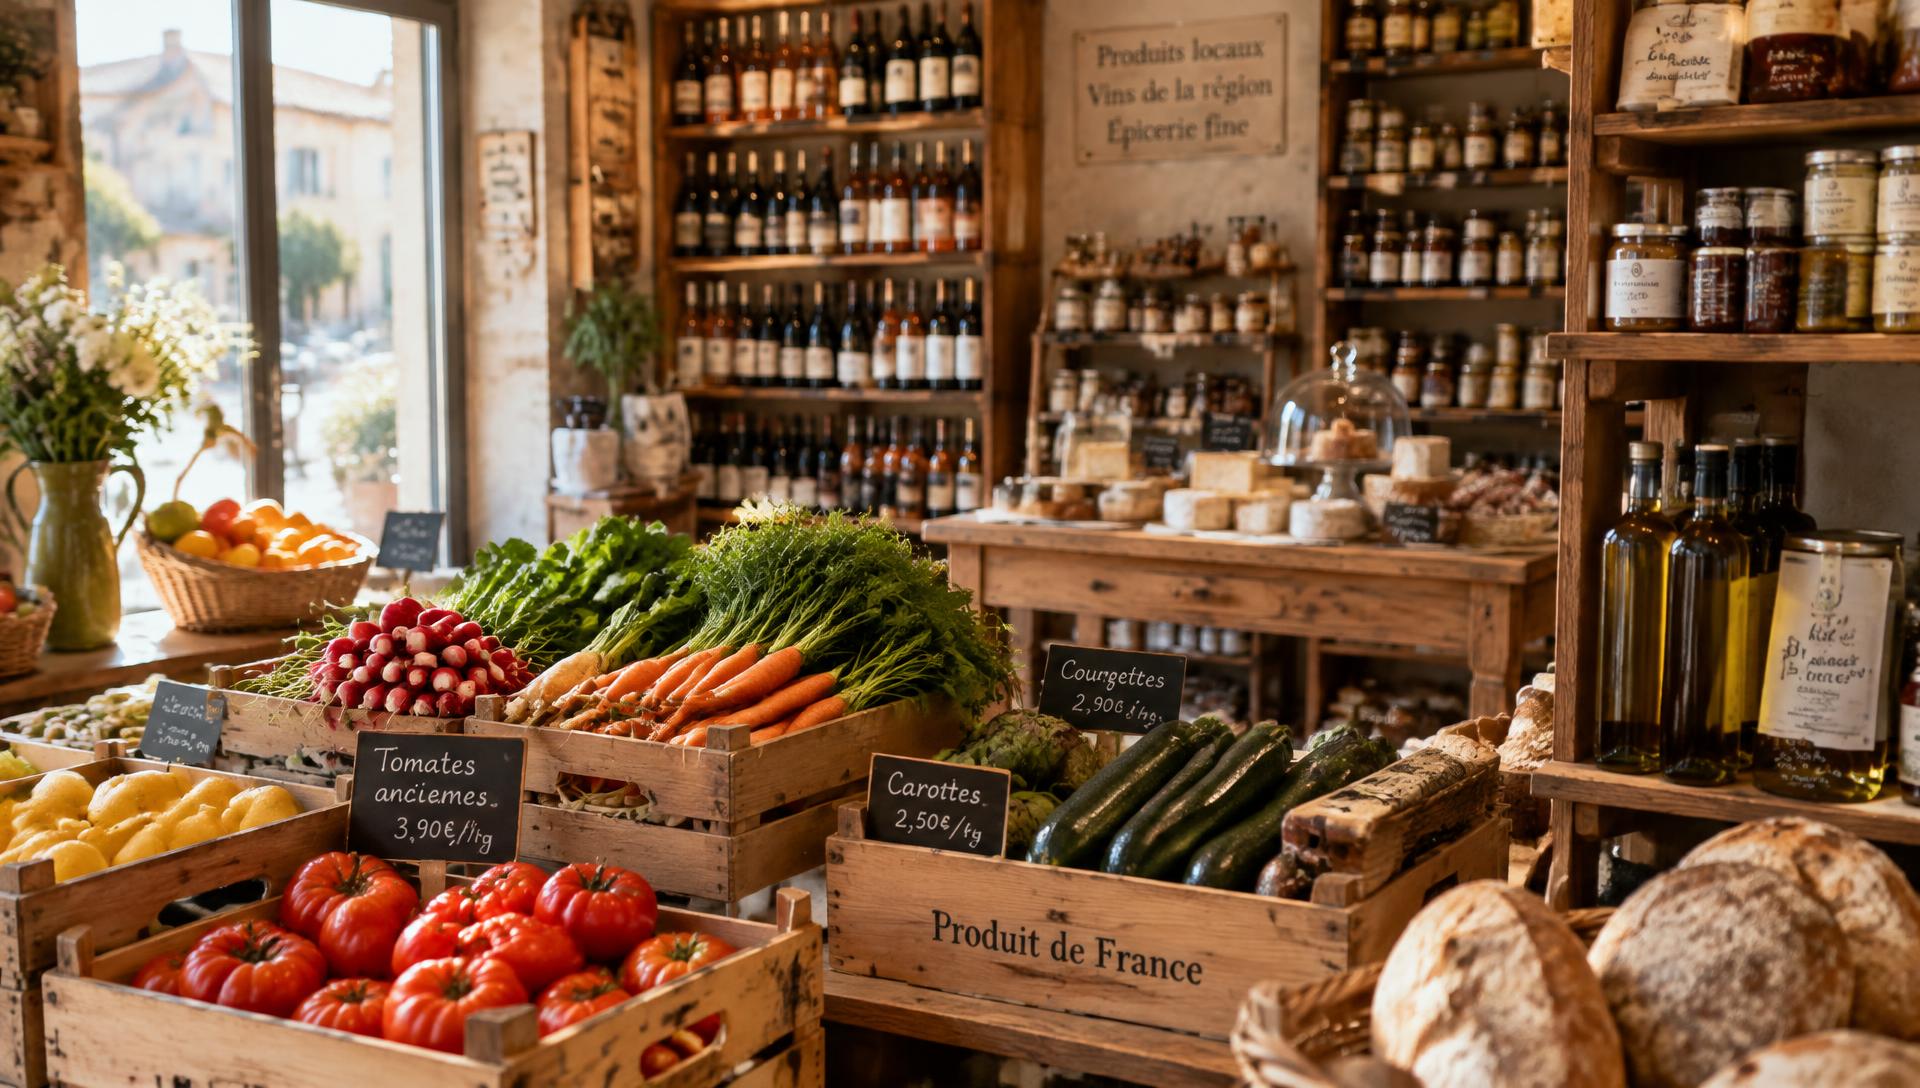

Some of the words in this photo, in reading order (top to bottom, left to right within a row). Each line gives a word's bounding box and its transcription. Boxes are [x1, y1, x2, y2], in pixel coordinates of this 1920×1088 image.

[1097, 42, 1185, 68] Produits
[1192, 37, 1264, 61] locaux
[1088, 83, 1136, 106] Vins
[1142, 79, 1169, 103] de
[1175, 76, 1194, 100] la
[1202, 74, 1272, 105] région
[1205, 112, 1249, 139] fine
[1061, 659, 1165, 691] Courgettes
[374, 747, 475, 776] Tomates
[888, 771, 981, 804] Carottes
[931, 909, 1040, 957] Produit
[1050, 930, 1085, 964] de
[1095, 936, 1203, 985] France
